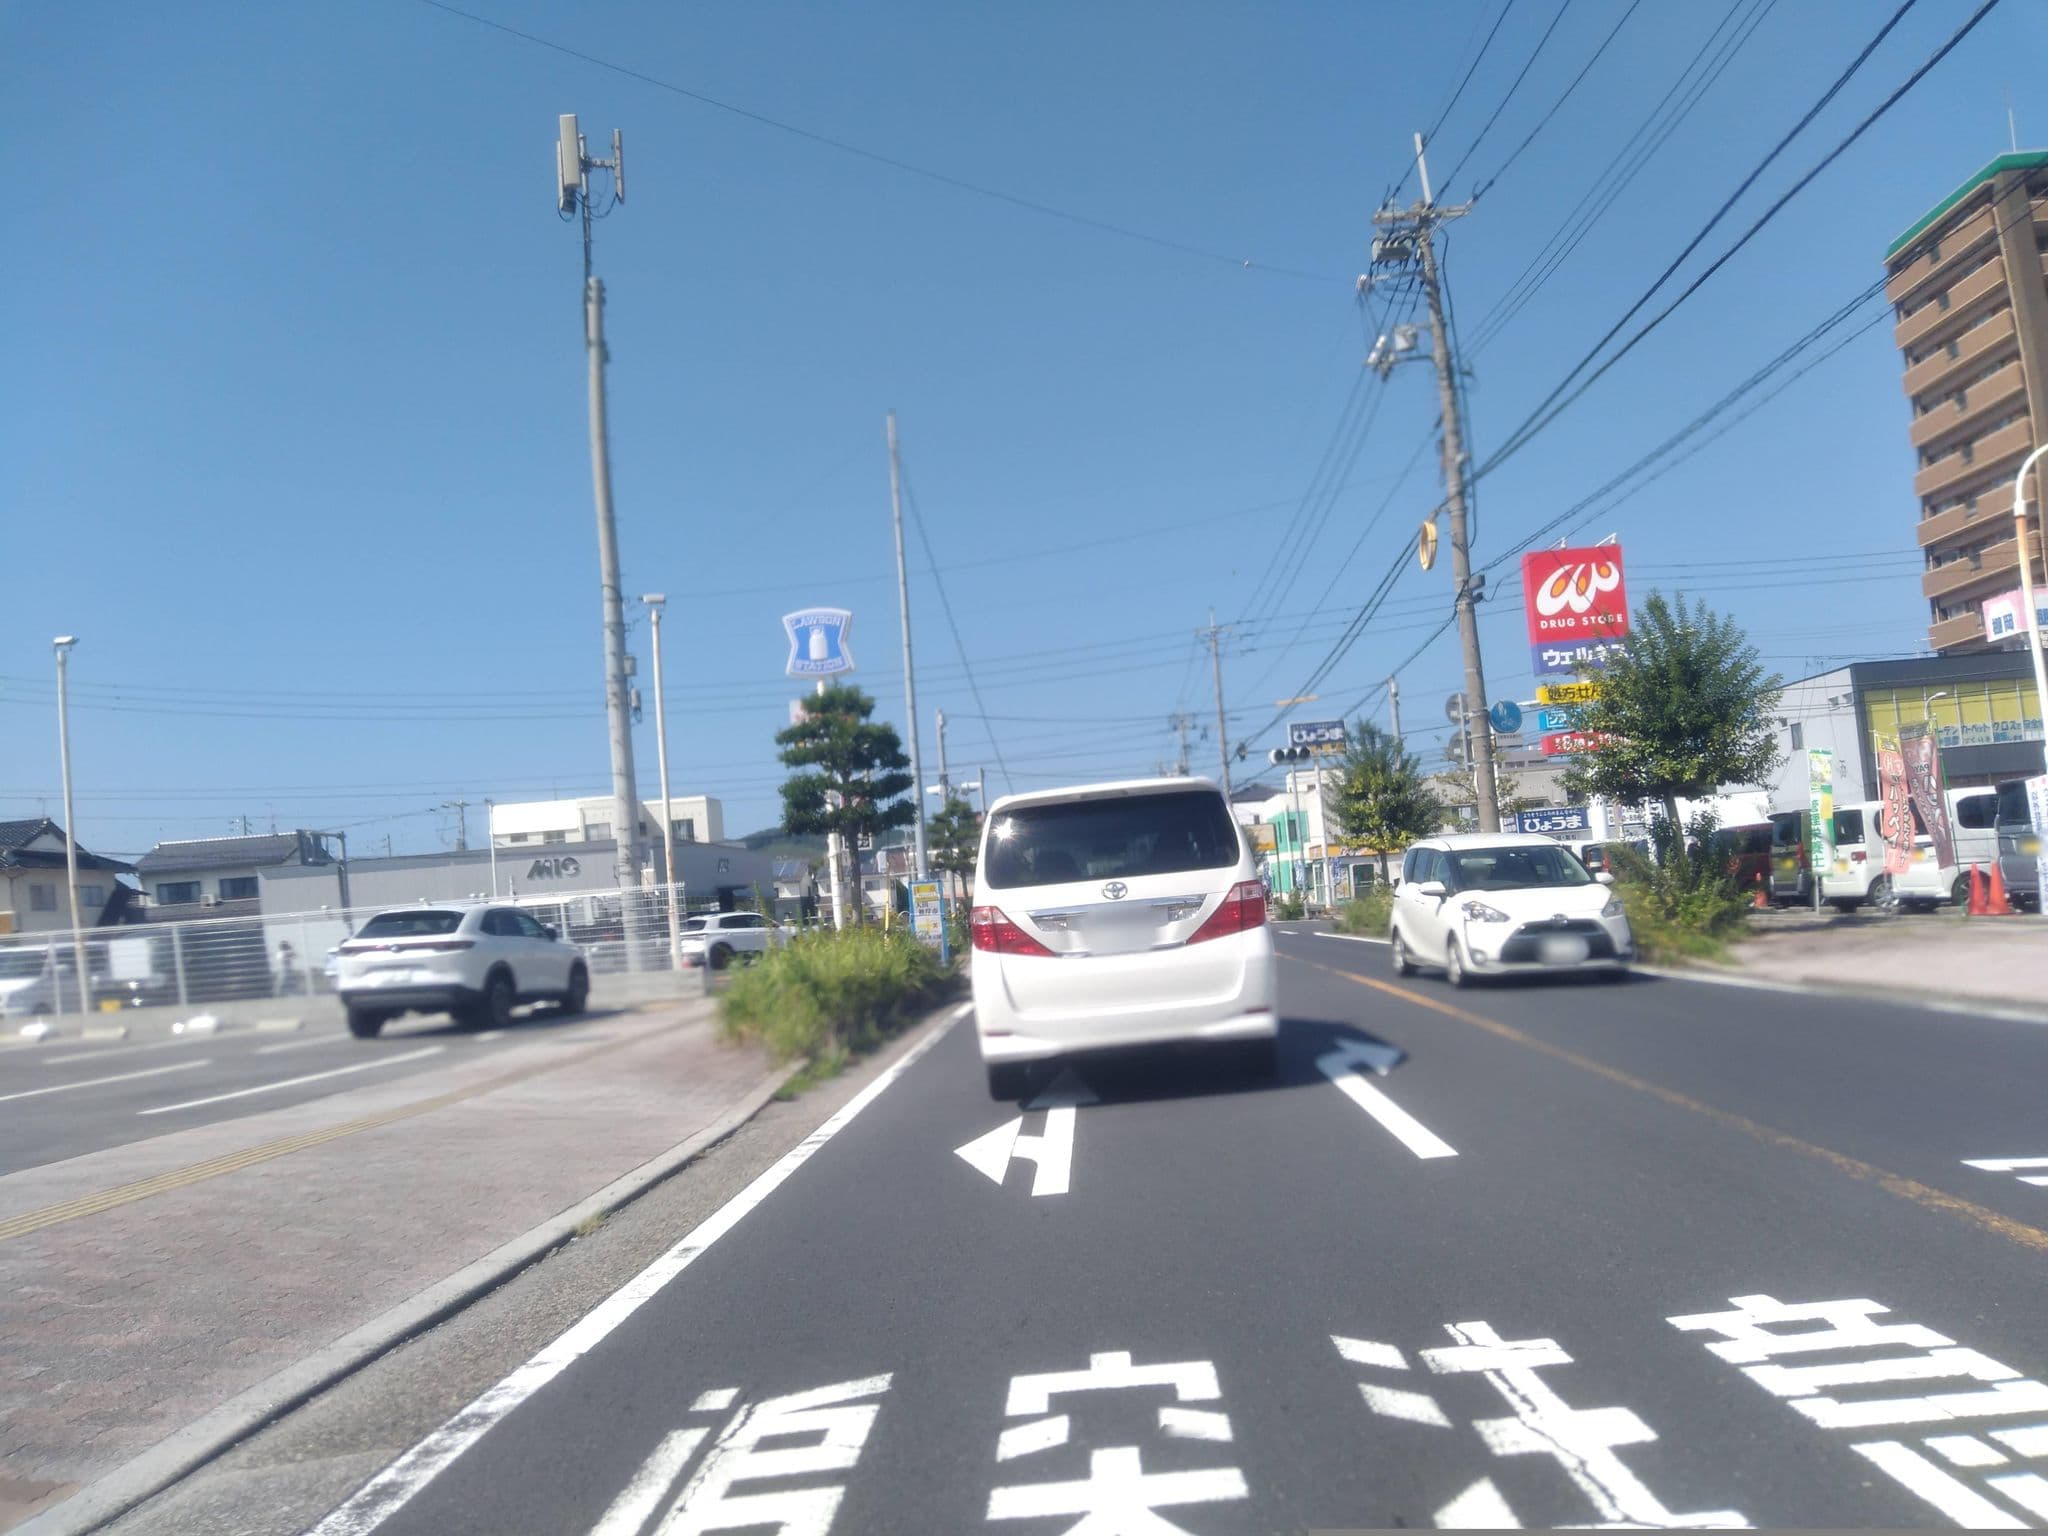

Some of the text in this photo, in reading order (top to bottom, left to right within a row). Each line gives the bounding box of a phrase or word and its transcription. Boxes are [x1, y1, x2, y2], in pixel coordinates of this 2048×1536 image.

[1540, 613, 1624, 629] DRUG STORE
[1523, 815, 1582, 832] ひょうま
